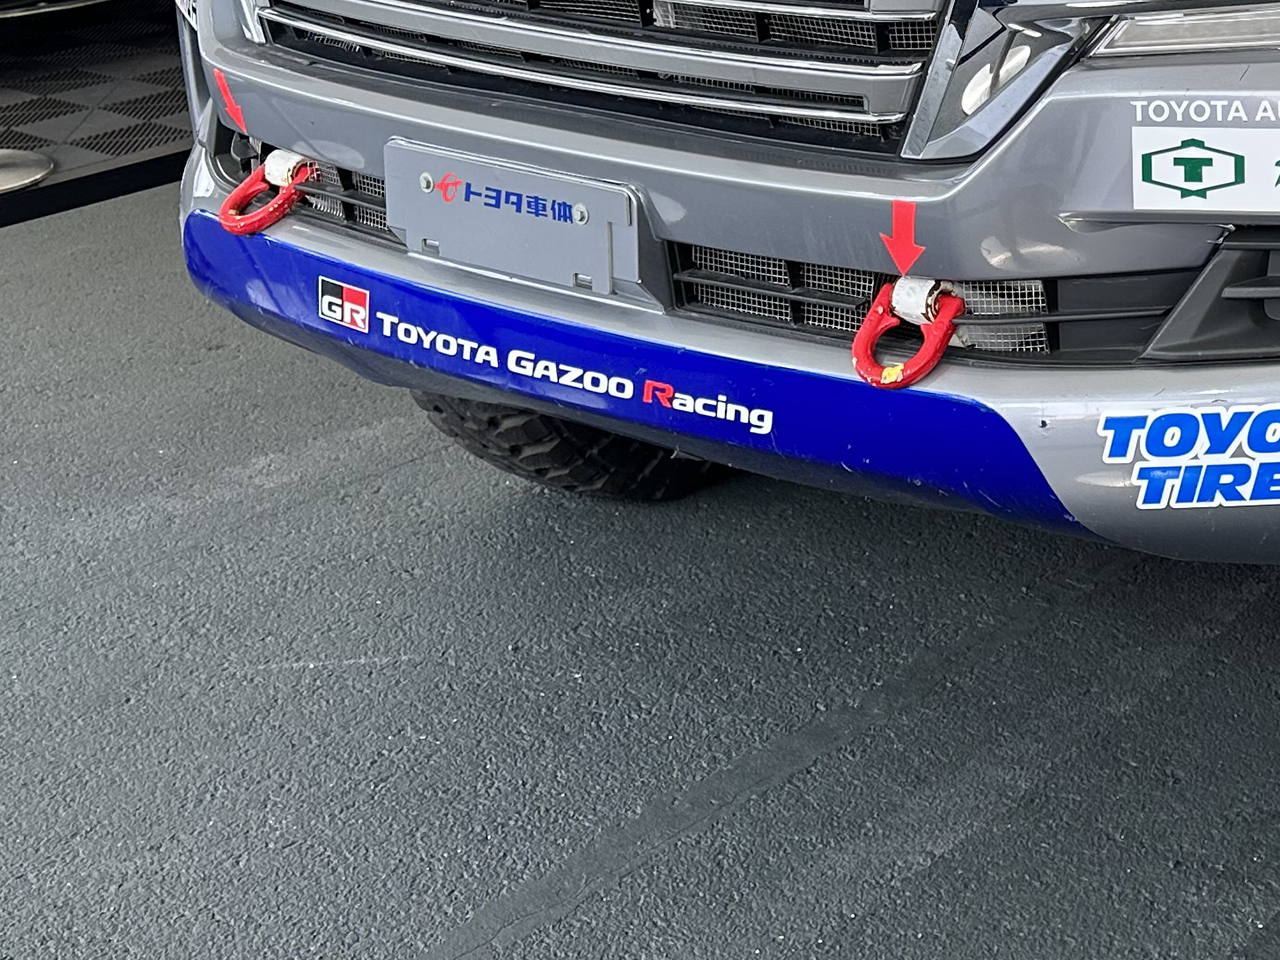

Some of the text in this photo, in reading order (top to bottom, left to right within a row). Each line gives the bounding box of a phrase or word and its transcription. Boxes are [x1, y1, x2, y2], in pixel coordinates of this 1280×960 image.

[1130, 100, 1248, 122] TOYOTA
[464, 187, 575, 225] トヨタ車体
[321, 295, 774, 435] GR TOYOTA GAZOO Racing
